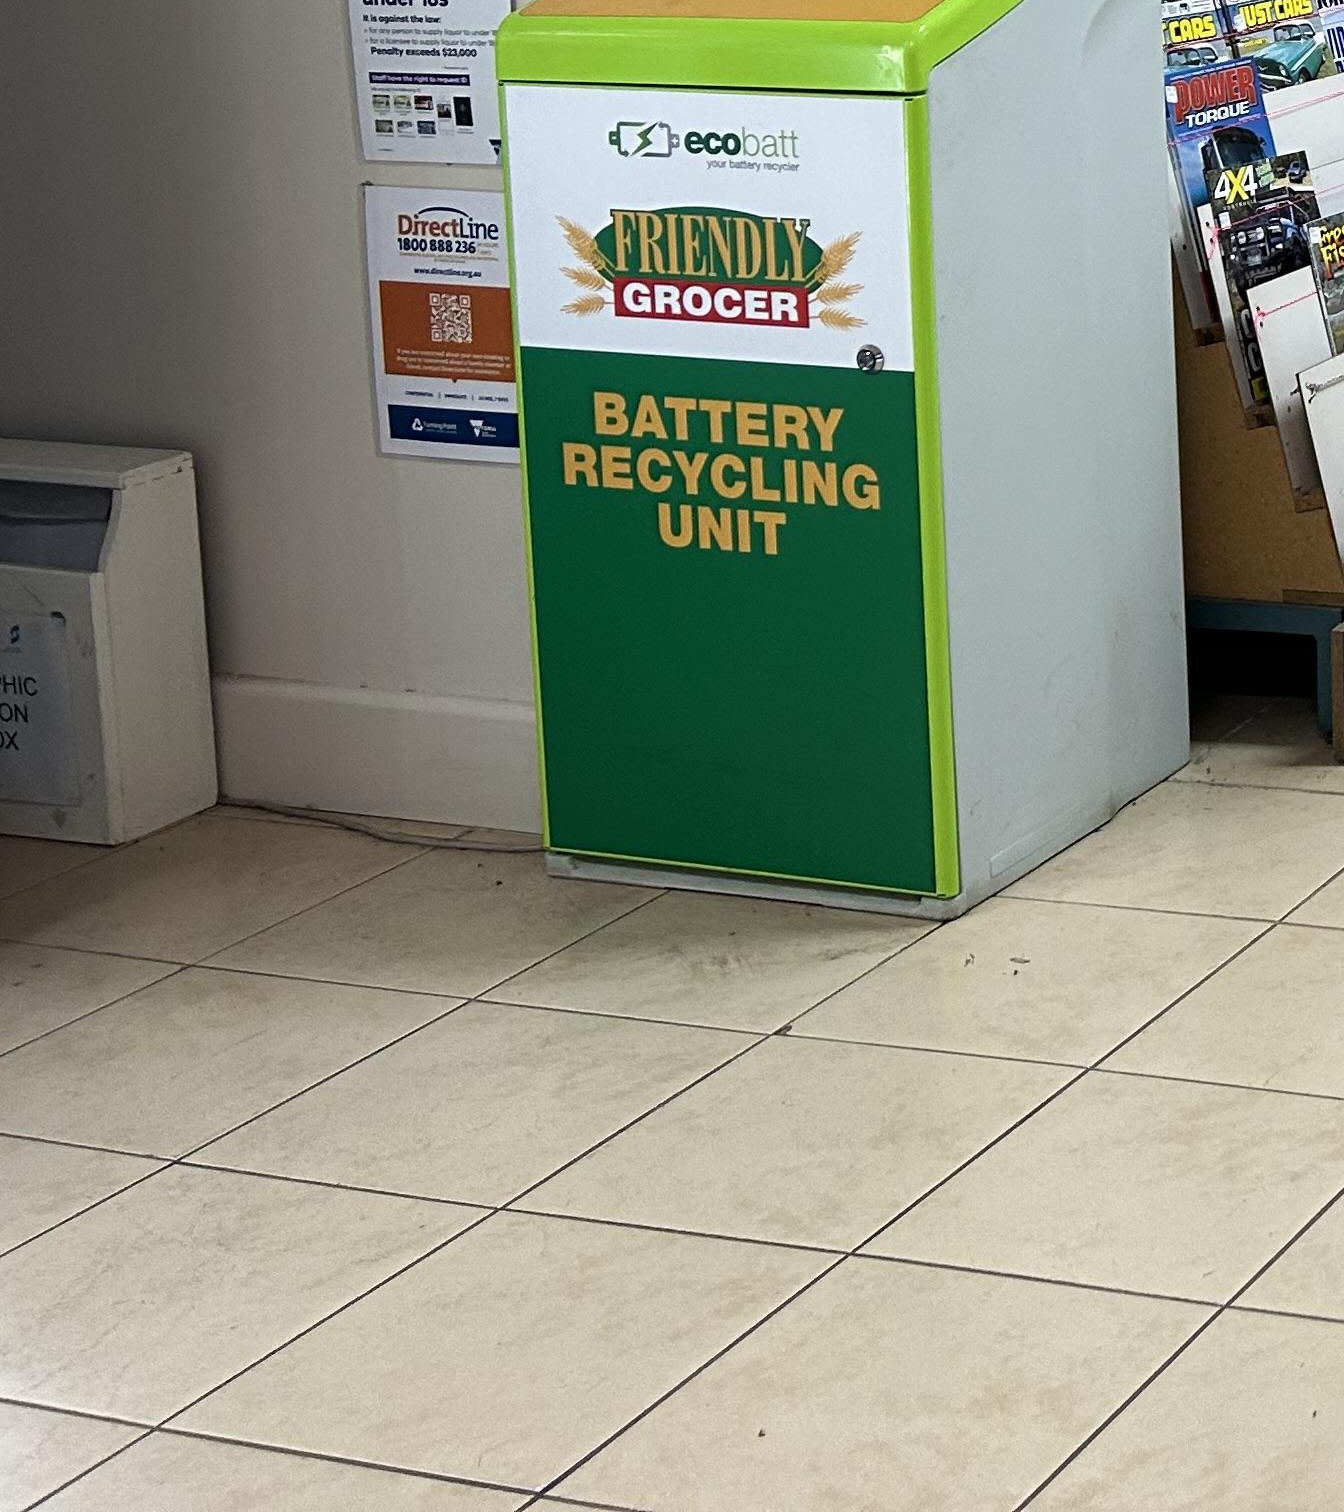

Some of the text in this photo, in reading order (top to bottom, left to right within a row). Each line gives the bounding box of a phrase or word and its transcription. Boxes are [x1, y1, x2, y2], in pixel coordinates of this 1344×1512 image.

[379, 15, 408, 24] against
[410, 15, 423, 23] the
[1168, 15, 1217, 45] CARS
[371, 47, 477, 57] Penalty exceeds $23,000
[1171, 66, 1257, 124] POWER
[1185, 100, 1250, 128] TORQUE
[684, 126, 799, 158] ecobatt
[706, 159, 799, 173] your battery recycler
[1214, 165, 1258, 204] 4X4
[398, 214, 498, 240] DirectLine
[398, 238, 476, 254] 1800 888 236
[610, 209, 810, 281] FRIENDLY
[623, 282, 799, 322] GROCER
[593, 391, 844, 452] BATTERY
[562, 442, 881, 510] RECYCLING
[657, 502, 787, 555] UNIT
[0, 676, 38, 696] HIC
